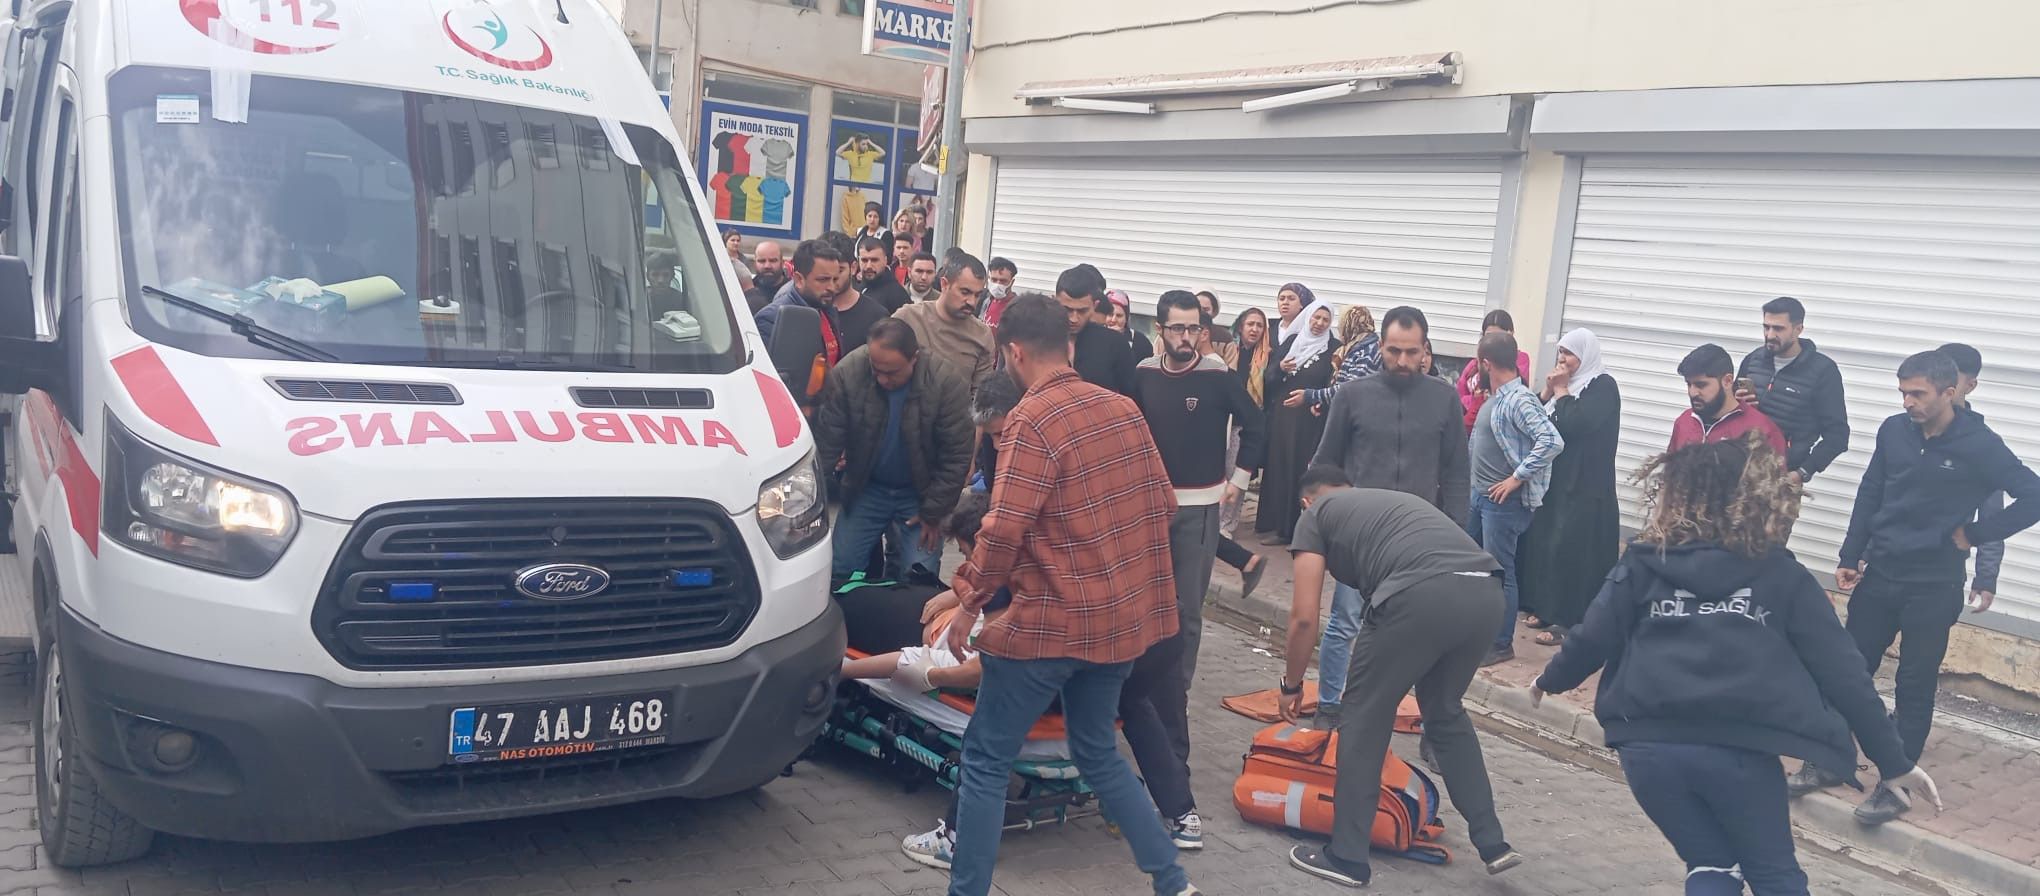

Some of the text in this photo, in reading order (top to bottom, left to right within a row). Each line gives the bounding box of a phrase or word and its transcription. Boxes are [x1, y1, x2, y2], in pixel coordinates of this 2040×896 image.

[249, 0, 340, 30] 112
[875, 8, 970, 44] MARKE
[466, 69, 519, 87] Sağlık
[718, 117, 795, 138] EVİN MODA TEKSTİL
[540, 571, 592, 593] Ford
[1650, 597, 1772, 626] ACİL SAĞLIK
[474, 699, 663, 747] 47 AAJ 468
[456, 735, 471, 747] TR
